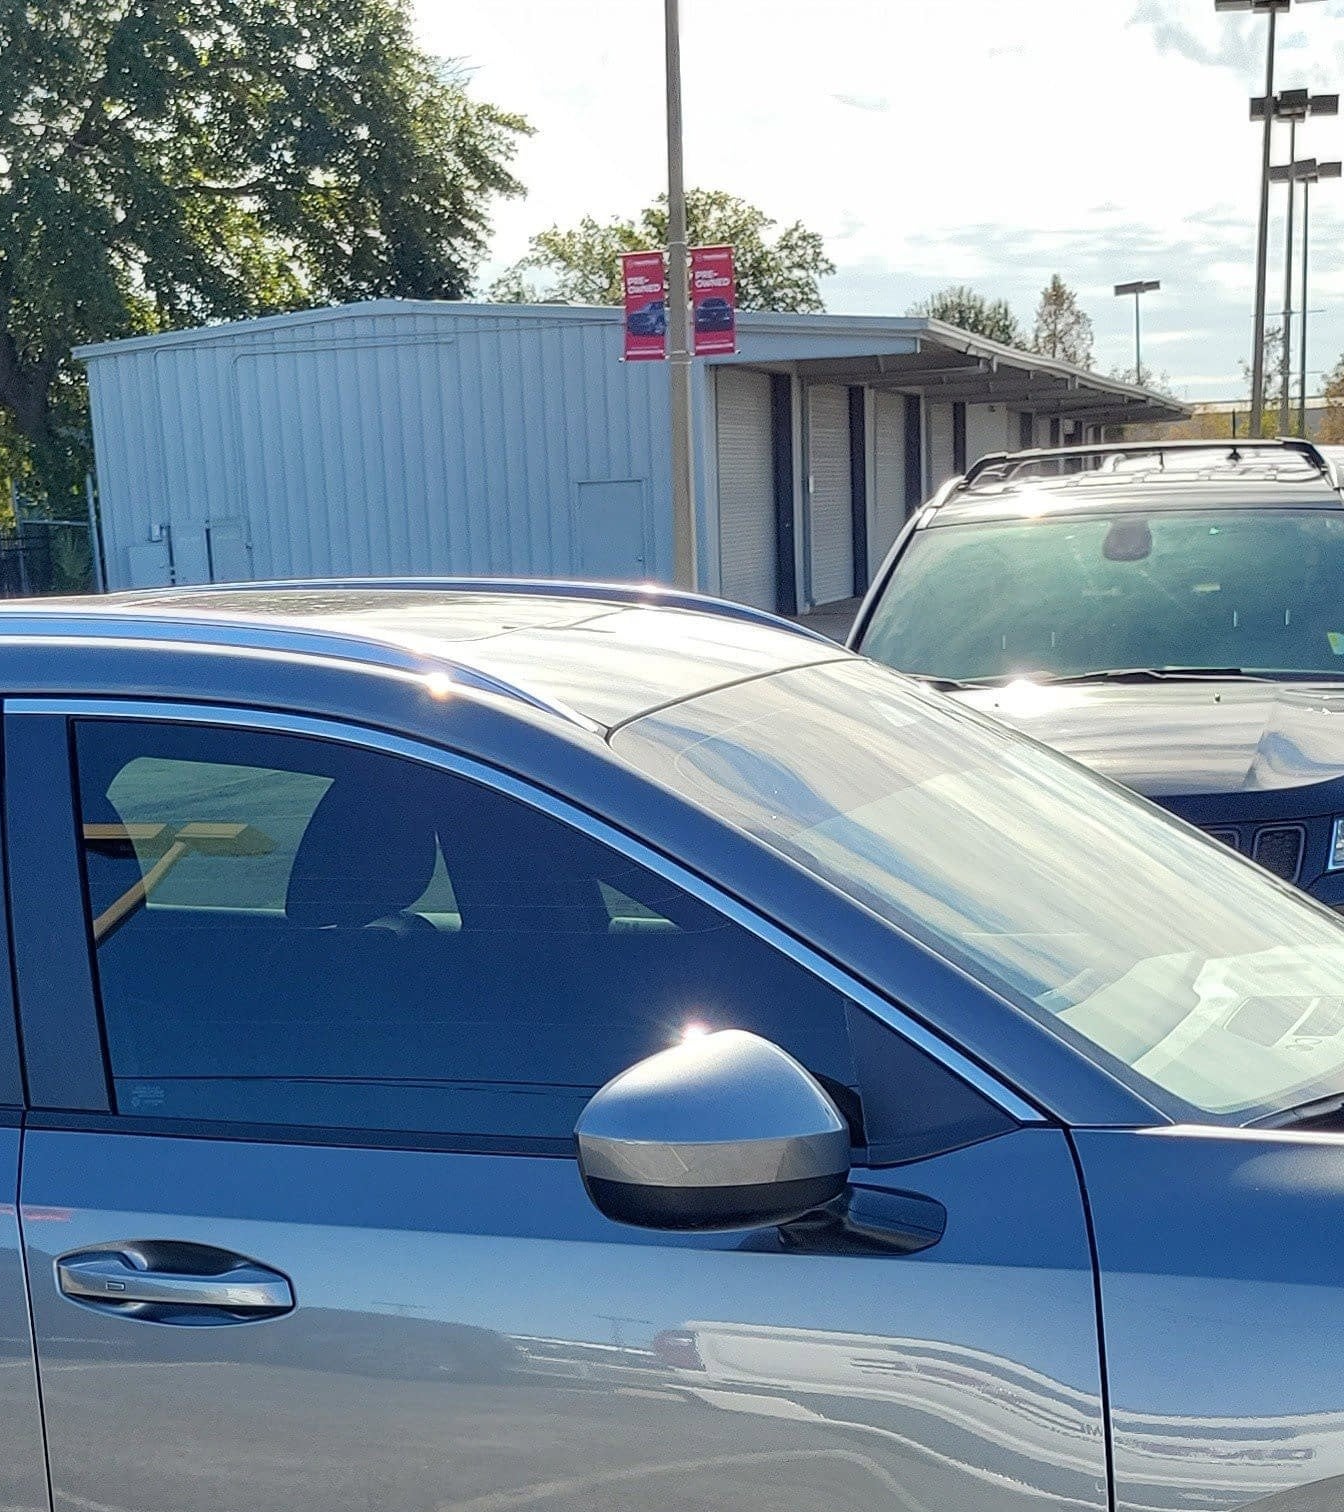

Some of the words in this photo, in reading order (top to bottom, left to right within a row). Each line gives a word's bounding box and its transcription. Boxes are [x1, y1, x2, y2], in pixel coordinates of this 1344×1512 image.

[695, 270, 718, 279] PRE-
[627, 276, 650, 285] PRE-
[695, 277, 731, 288] OWNED
[627, 283, 661, 294] OWNED
